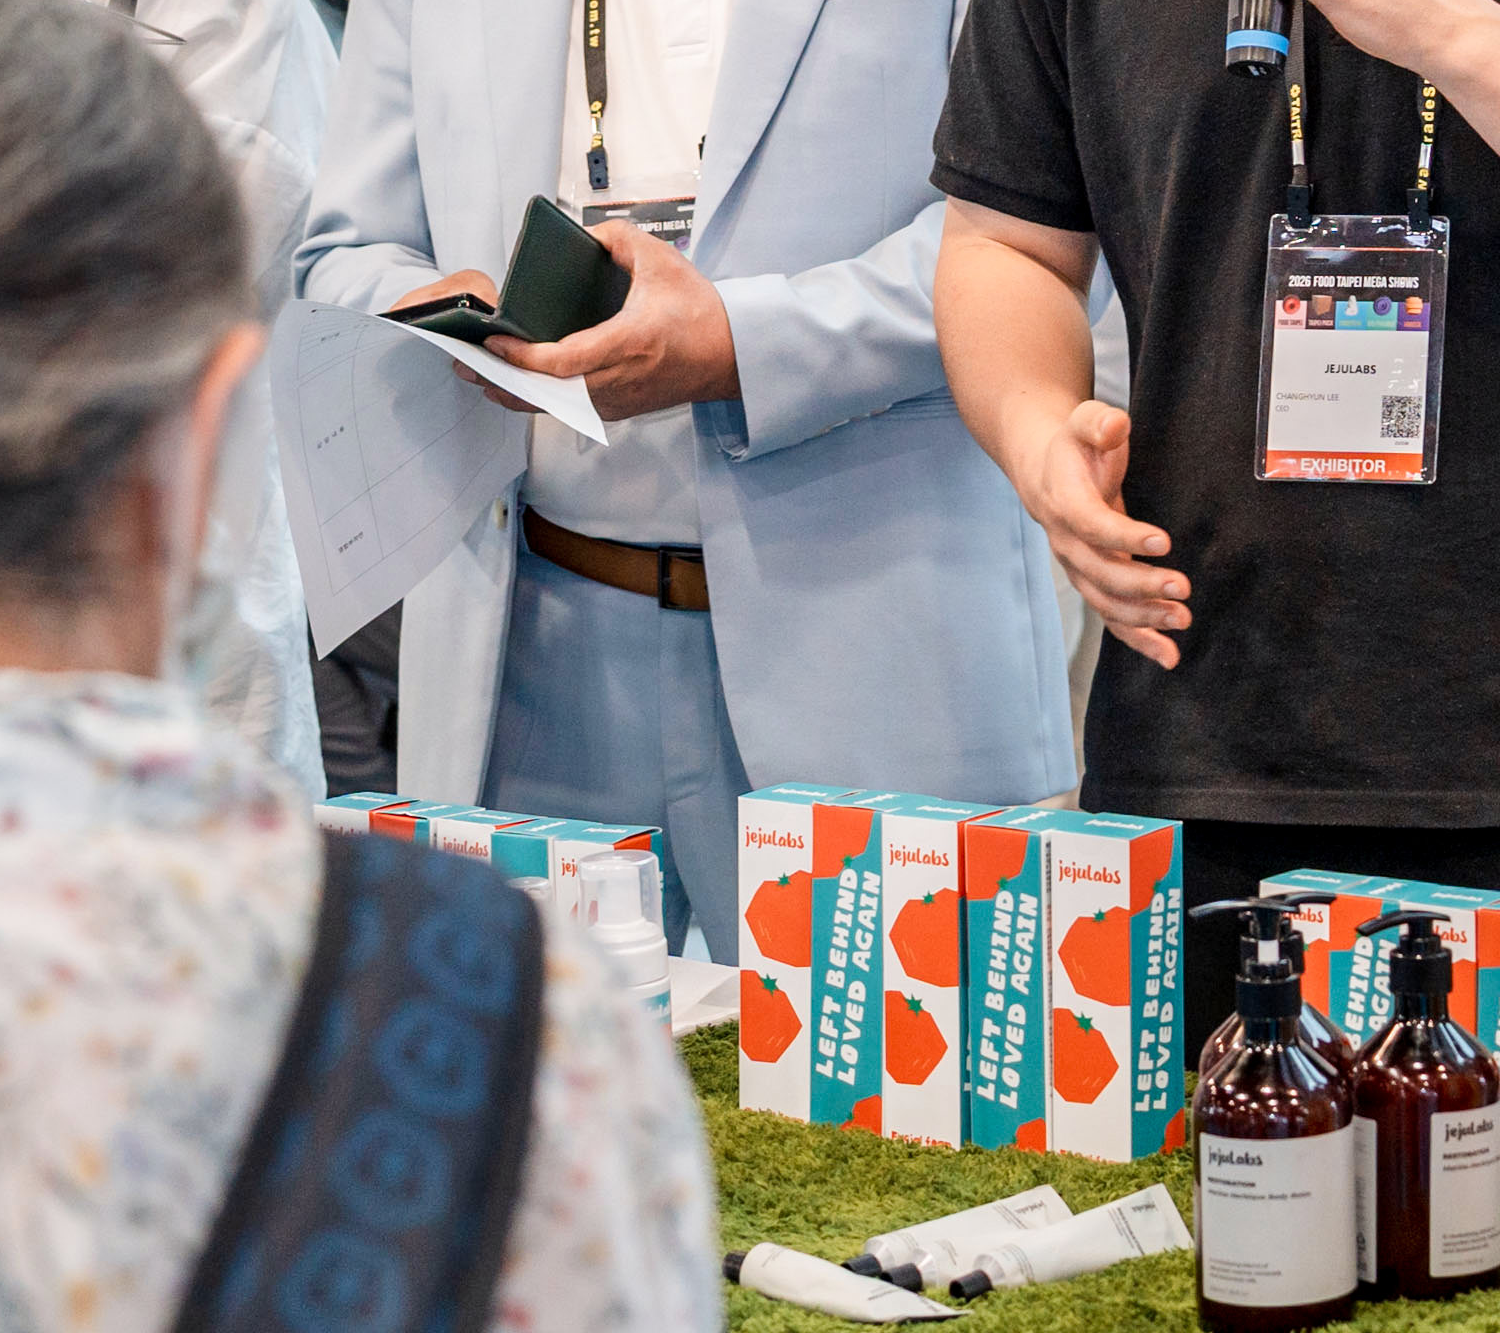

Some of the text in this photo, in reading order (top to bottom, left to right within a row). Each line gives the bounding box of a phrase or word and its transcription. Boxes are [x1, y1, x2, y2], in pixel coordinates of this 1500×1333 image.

[1289, 99, 1303, 142] TAITR
[1288, 275, 1420, 289] 2026 FOOD TAIPEI MEGA SHOWS
[1324, 363, 1377, 375] JEJULABS
[1276, 392, 1340, 402] CHANGHYUN LEE
[1300, 458, 1386, 474] EXHIBITOR
[744, 825, 805, 850] jejulabs
[889, 843, 950, 868] jejulabs
[1058, 859, 1122, 885] jejulabs
[815, 867, 859, 1080] LEFT BEHIND
[837, 870, 881, 1086] LOVED AGAIN
[976, 888, 1015, 1102] LEFT BEHIND
[999, 892, 1039, 1111] LOVED AGAIN
[1133, 891, 1166, 1113] LEFT BEHIND
[1152, 887, 1182, 1111] LOVED AGAIN
